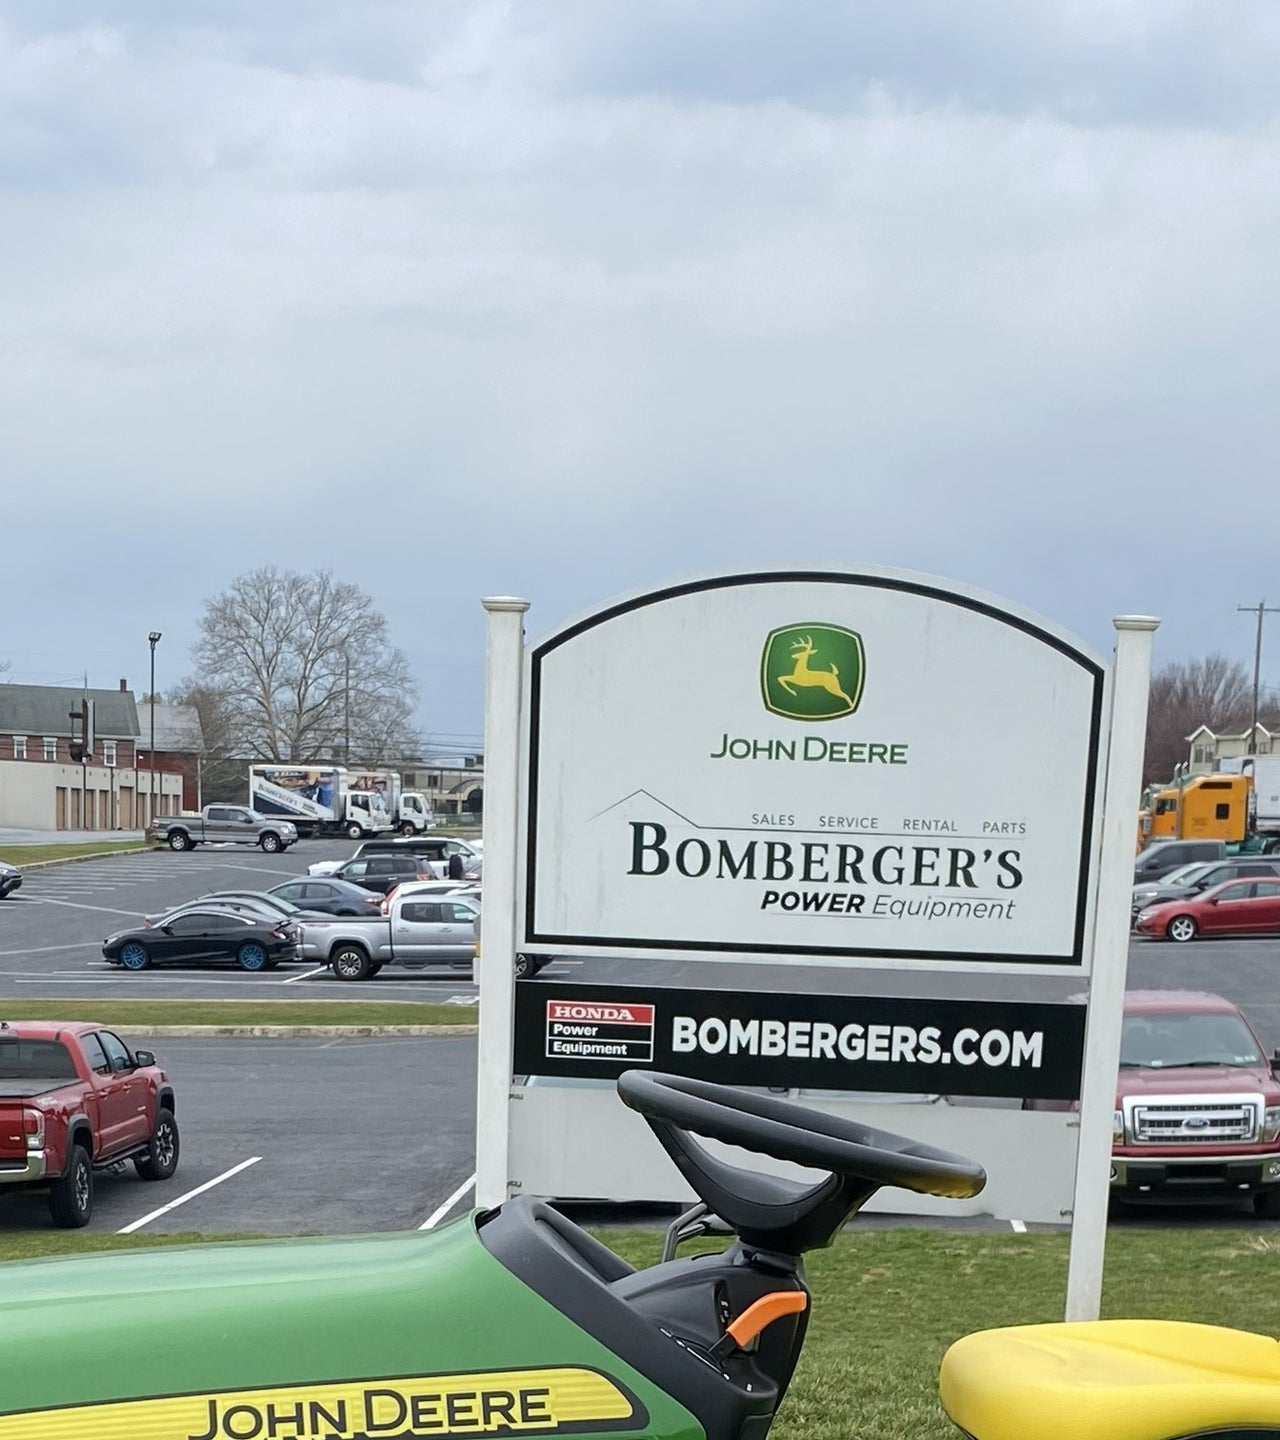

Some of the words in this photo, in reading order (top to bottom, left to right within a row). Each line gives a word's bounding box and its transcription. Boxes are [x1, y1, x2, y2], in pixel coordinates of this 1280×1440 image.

[710, 733, 796, 762] JOHN
[803, 736, 909, 765] DEERE
[751, 813, 795, 827] SALES
[819, 815, 878, 829] SERVICE
[902, 818, 958, 832] RENTAL
[982, 821, 1026, 835] PARTS
[626, 821, 1023, 892] BOMBERGER'S
[761, 890, 865, 914] POWER
[873, 895, 1016, 921] Equipment
[553, 1004, 634, 1021] HONDA
[553, 1024, 598, 1037] Power
[672, 1016, 1044, 1068] BOMBERGERS.COM
[552, 1042, 627, 1057] Equipment
[363, 1388, 552, 1432] DEERE
